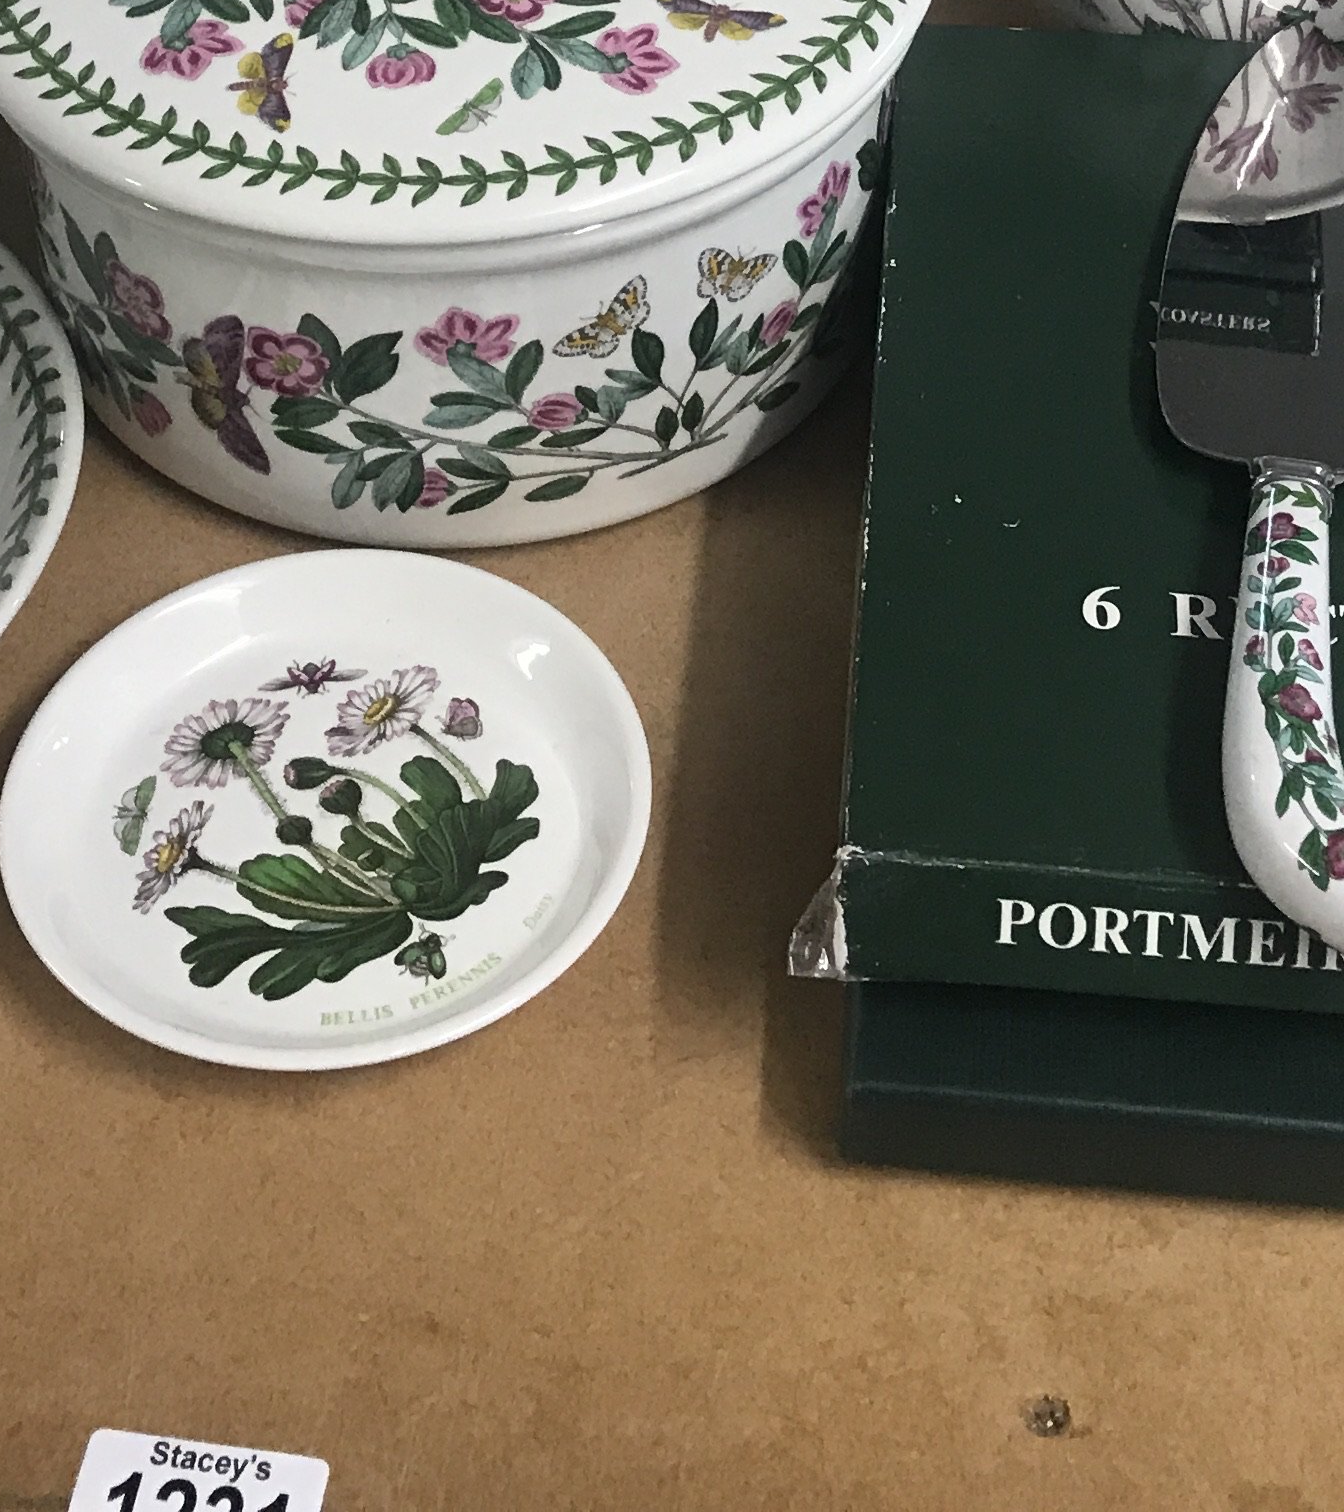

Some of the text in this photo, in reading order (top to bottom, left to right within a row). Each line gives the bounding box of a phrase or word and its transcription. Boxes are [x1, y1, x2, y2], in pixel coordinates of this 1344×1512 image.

[1082, 586, 1122, 630] 6
[320, 952, 503, 1027] BELLIS PERENNIS
[149, 1441, 273, 1483] Stacey's
